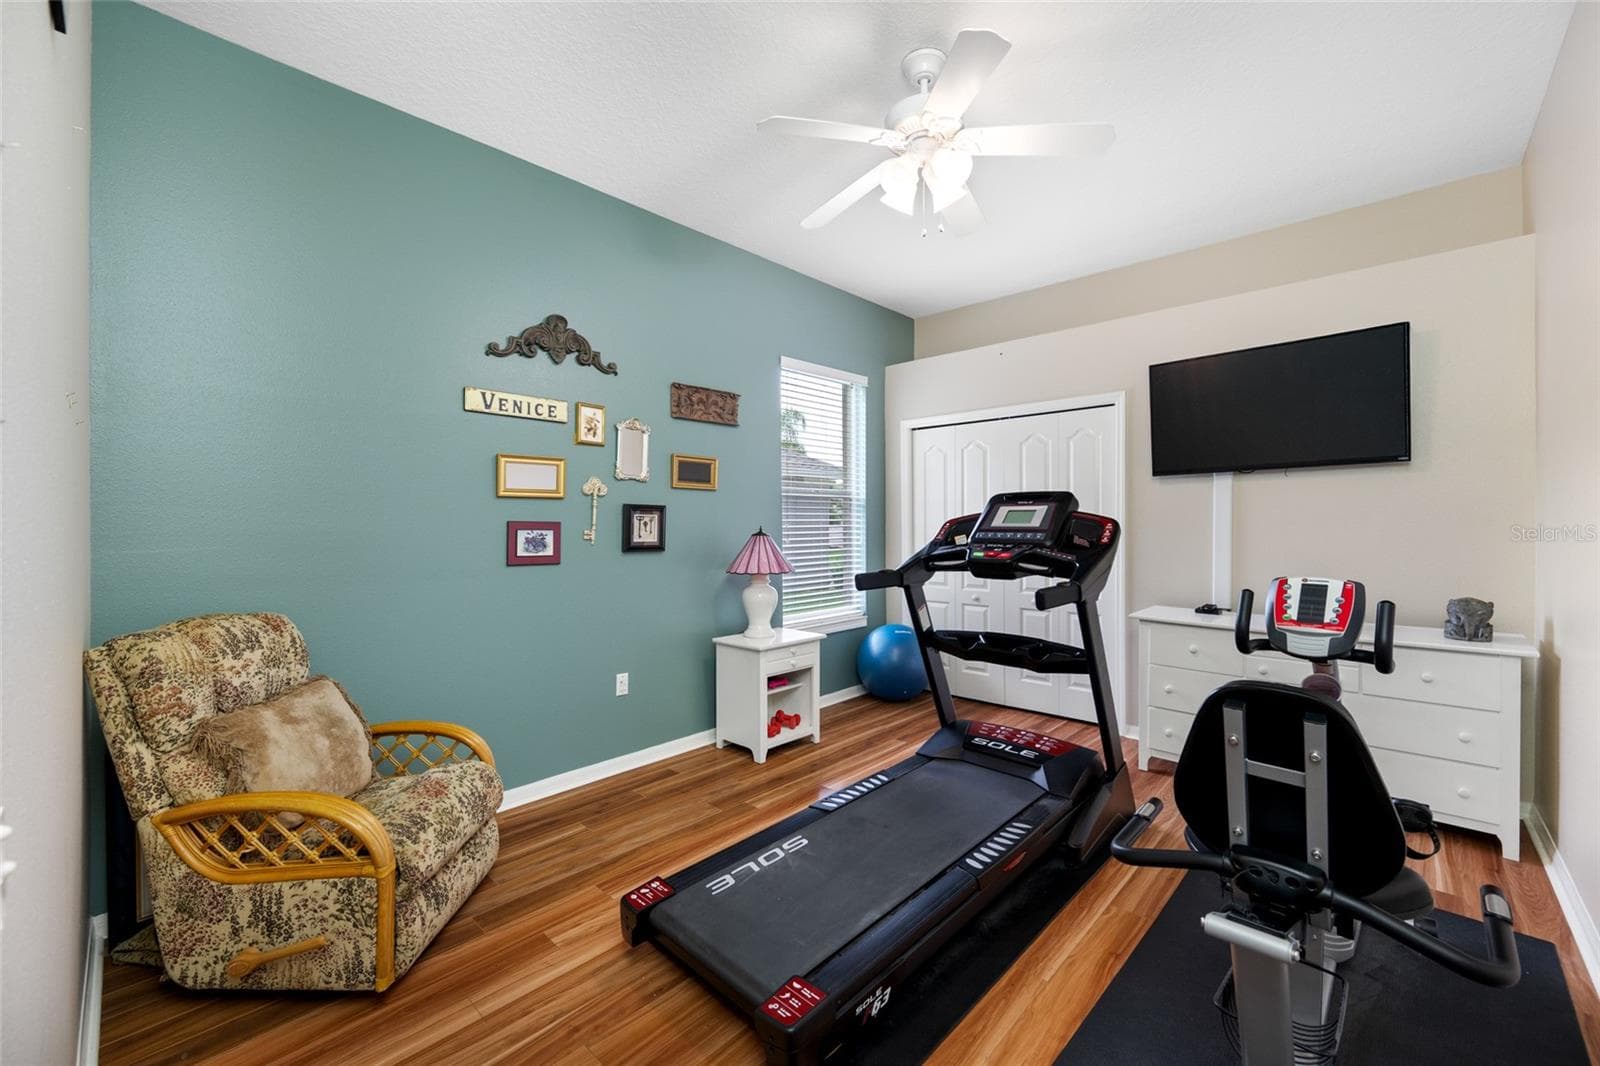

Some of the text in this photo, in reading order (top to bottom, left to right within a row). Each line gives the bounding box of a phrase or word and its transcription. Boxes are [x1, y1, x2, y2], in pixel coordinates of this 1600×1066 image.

[480, 391, 557, 418] VENICE
[971, 737, 1039, 759] SOLE
[706, 835, 808, 895] SOLE
[856, 986, 883, 1016] SOLE
